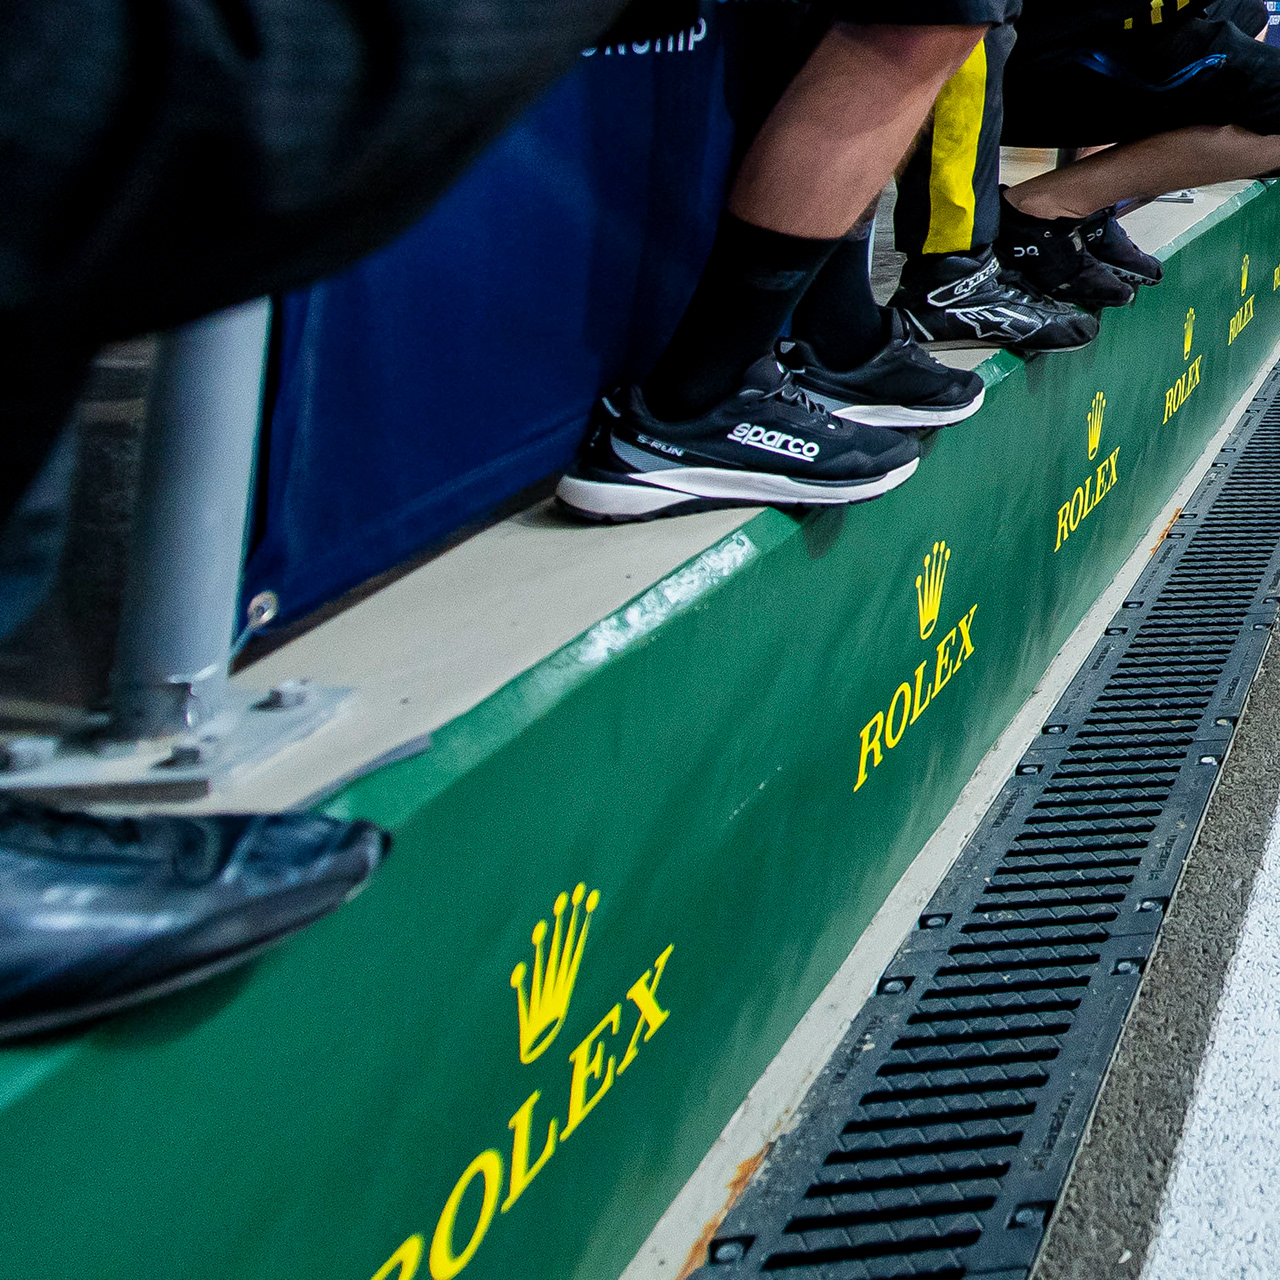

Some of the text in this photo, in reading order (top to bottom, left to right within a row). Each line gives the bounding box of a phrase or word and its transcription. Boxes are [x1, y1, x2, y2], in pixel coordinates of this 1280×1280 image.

[1228, 296, 1254, 346] ROLEX
[1163, 355, 1202, 424] ROLEX
[729, 422, 820, 459] sparco
[1054, 447, 1121, 552] ROLEX
[854, 604, 978, 793] ROLEX
